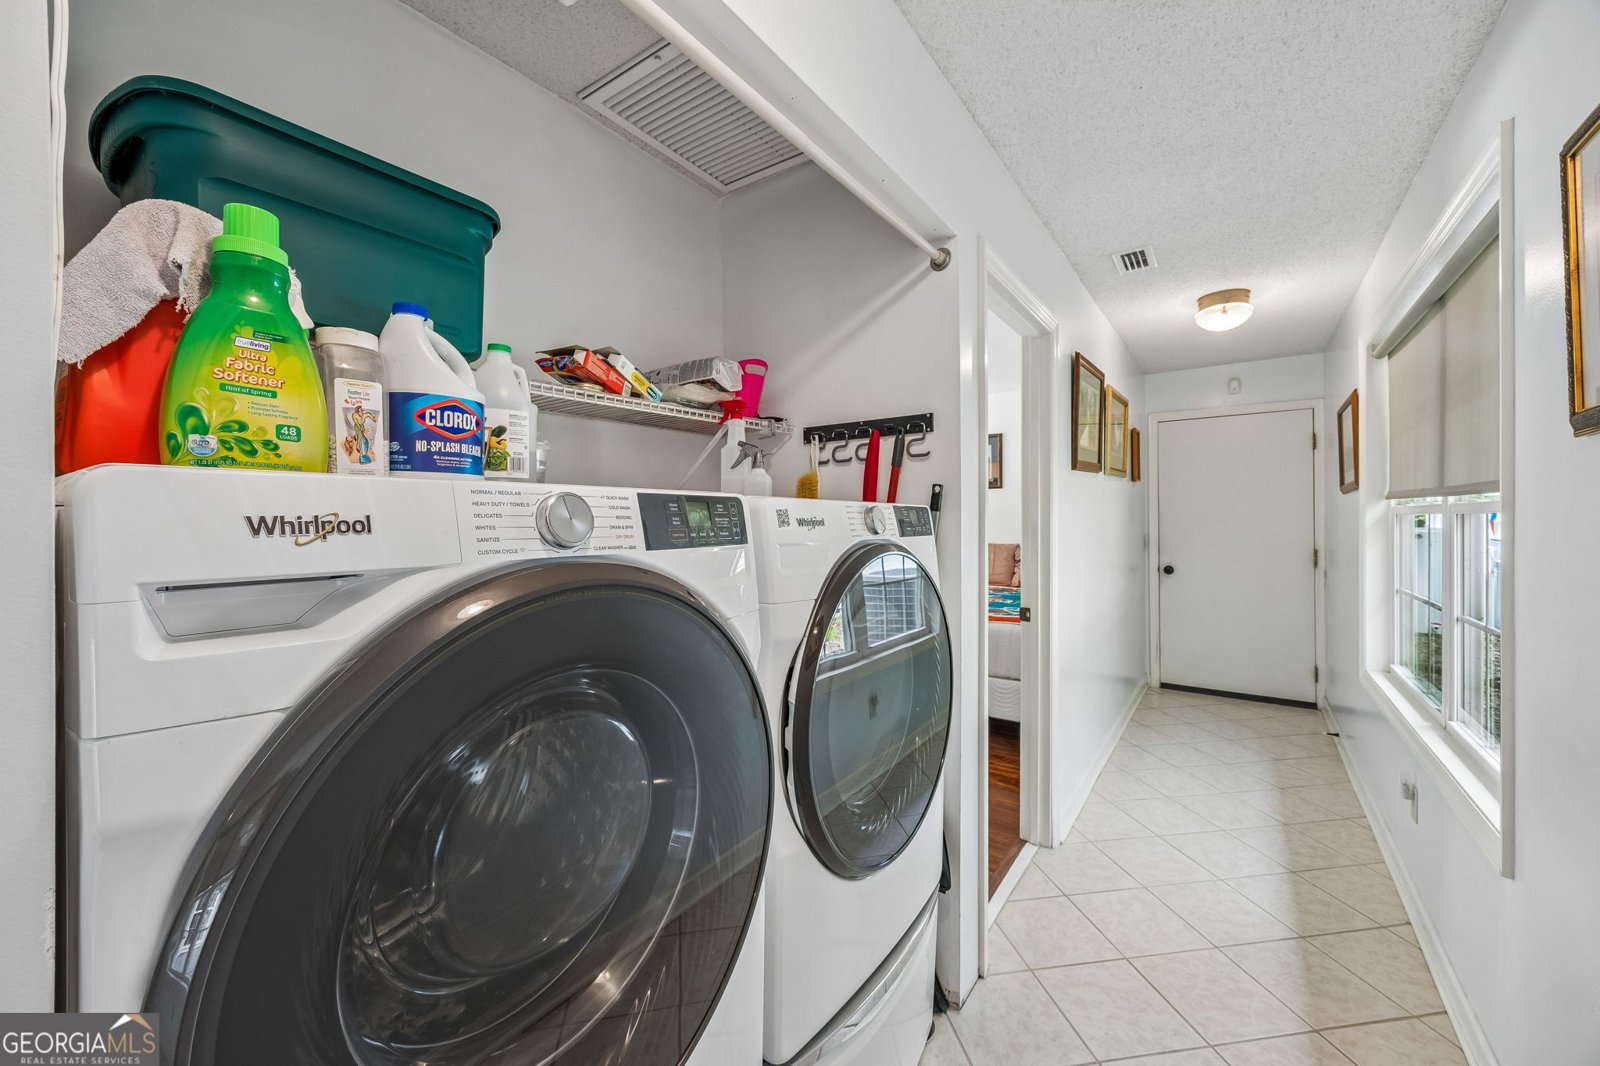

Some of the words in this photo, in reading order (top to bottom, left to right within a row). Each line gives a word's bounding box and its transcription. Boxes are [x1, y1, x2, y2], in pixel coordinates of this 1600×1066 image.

[238, 349, 267, 362] Ultra
[225, 356, 276, 375] Fabric
[213, 367, 285, 389] Softener
[250, 389, 272, 397] Spring
[425, 409, 477, 430] CLOROX
[280, 426, 297, 436] 48
[415, 440, 460, 453] NO-SPLASH
[461, 444, 481, 457] BLEACH
[244, 514, 372, 541] Whirlpool
[796, 516, 825, 530] Whirlpool
